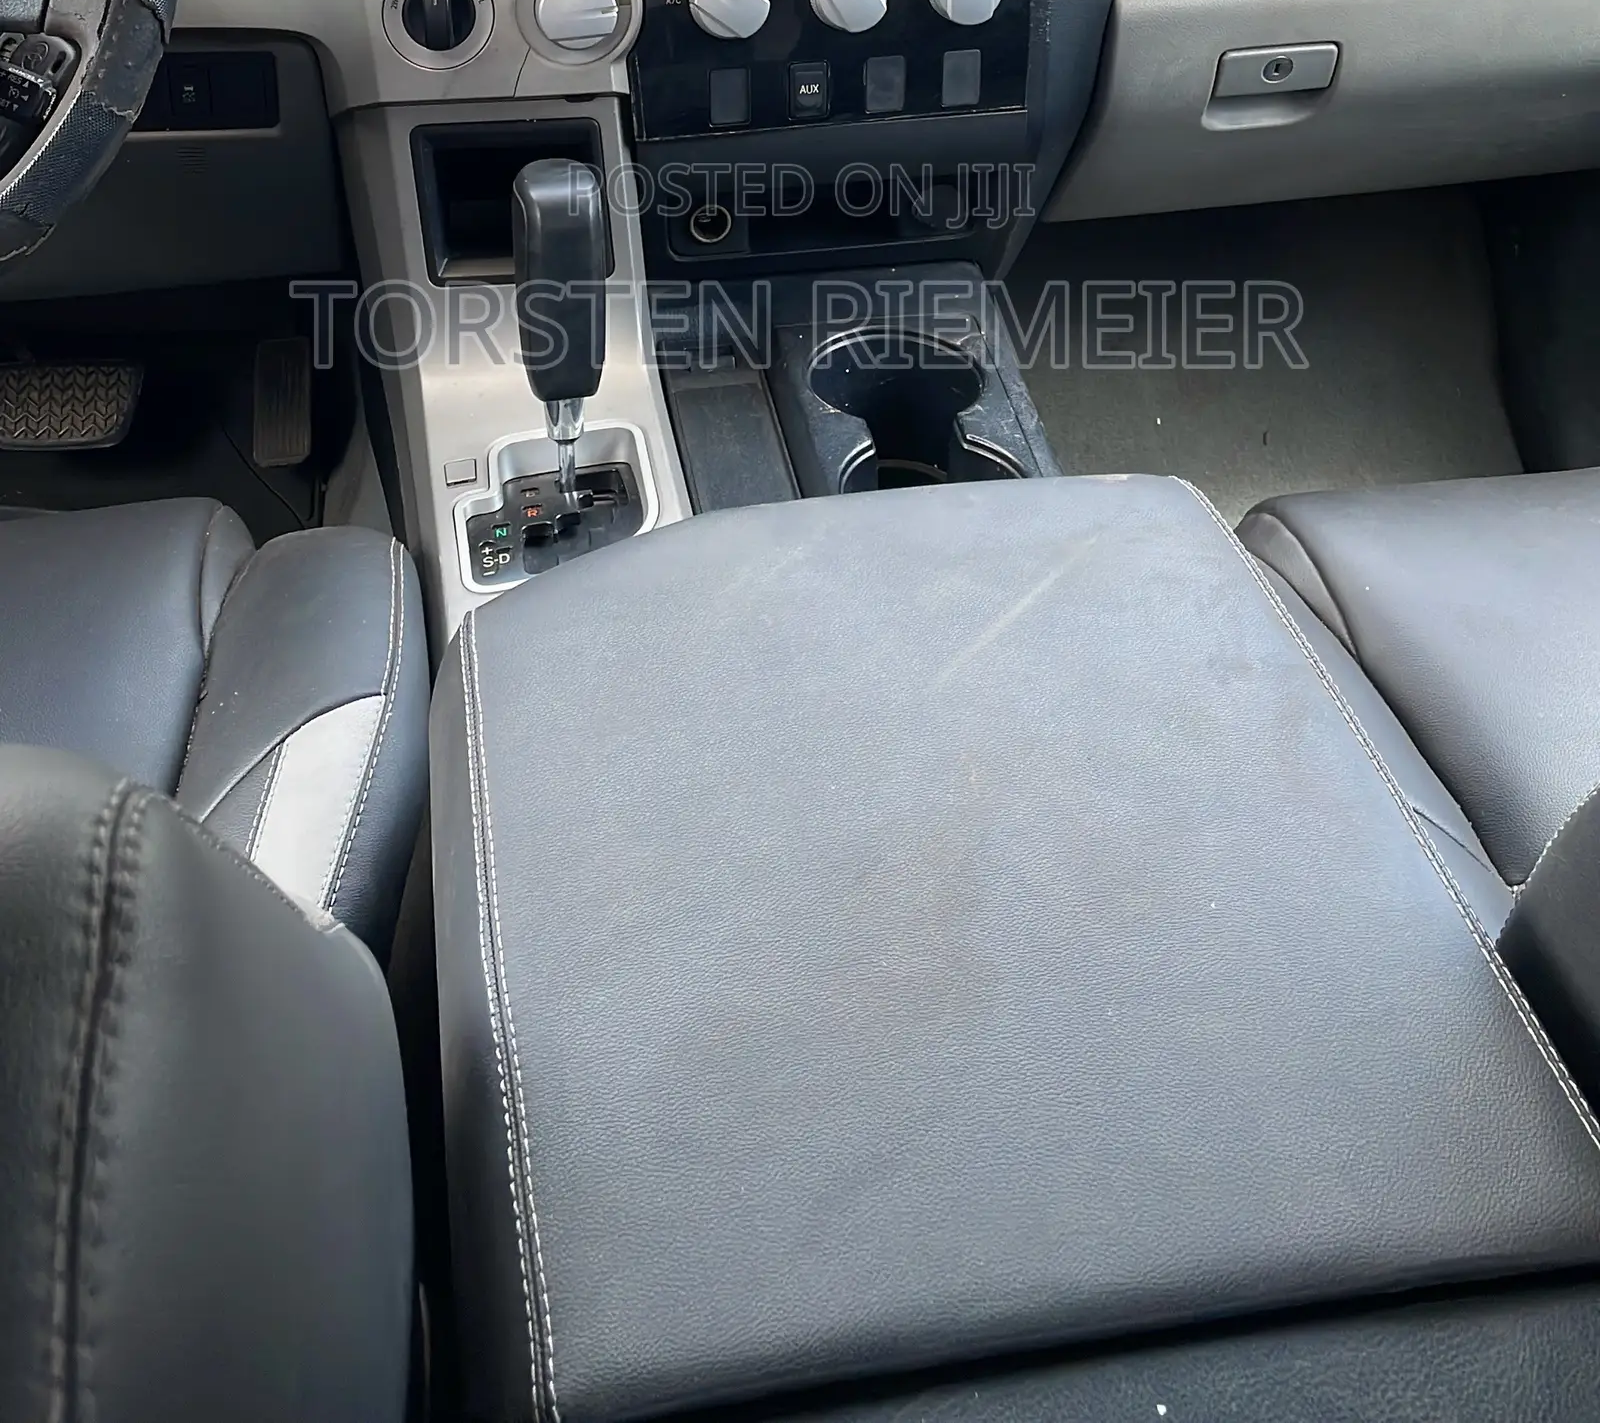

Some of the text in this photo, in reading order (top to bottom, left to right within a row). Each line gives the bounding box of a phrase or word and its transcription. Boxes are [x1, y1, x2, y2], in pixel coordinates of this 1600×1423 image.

[799, 83, 820, 95] AUX
[527, 508, 538, 518] R
[495, 528, 507, 537] N
